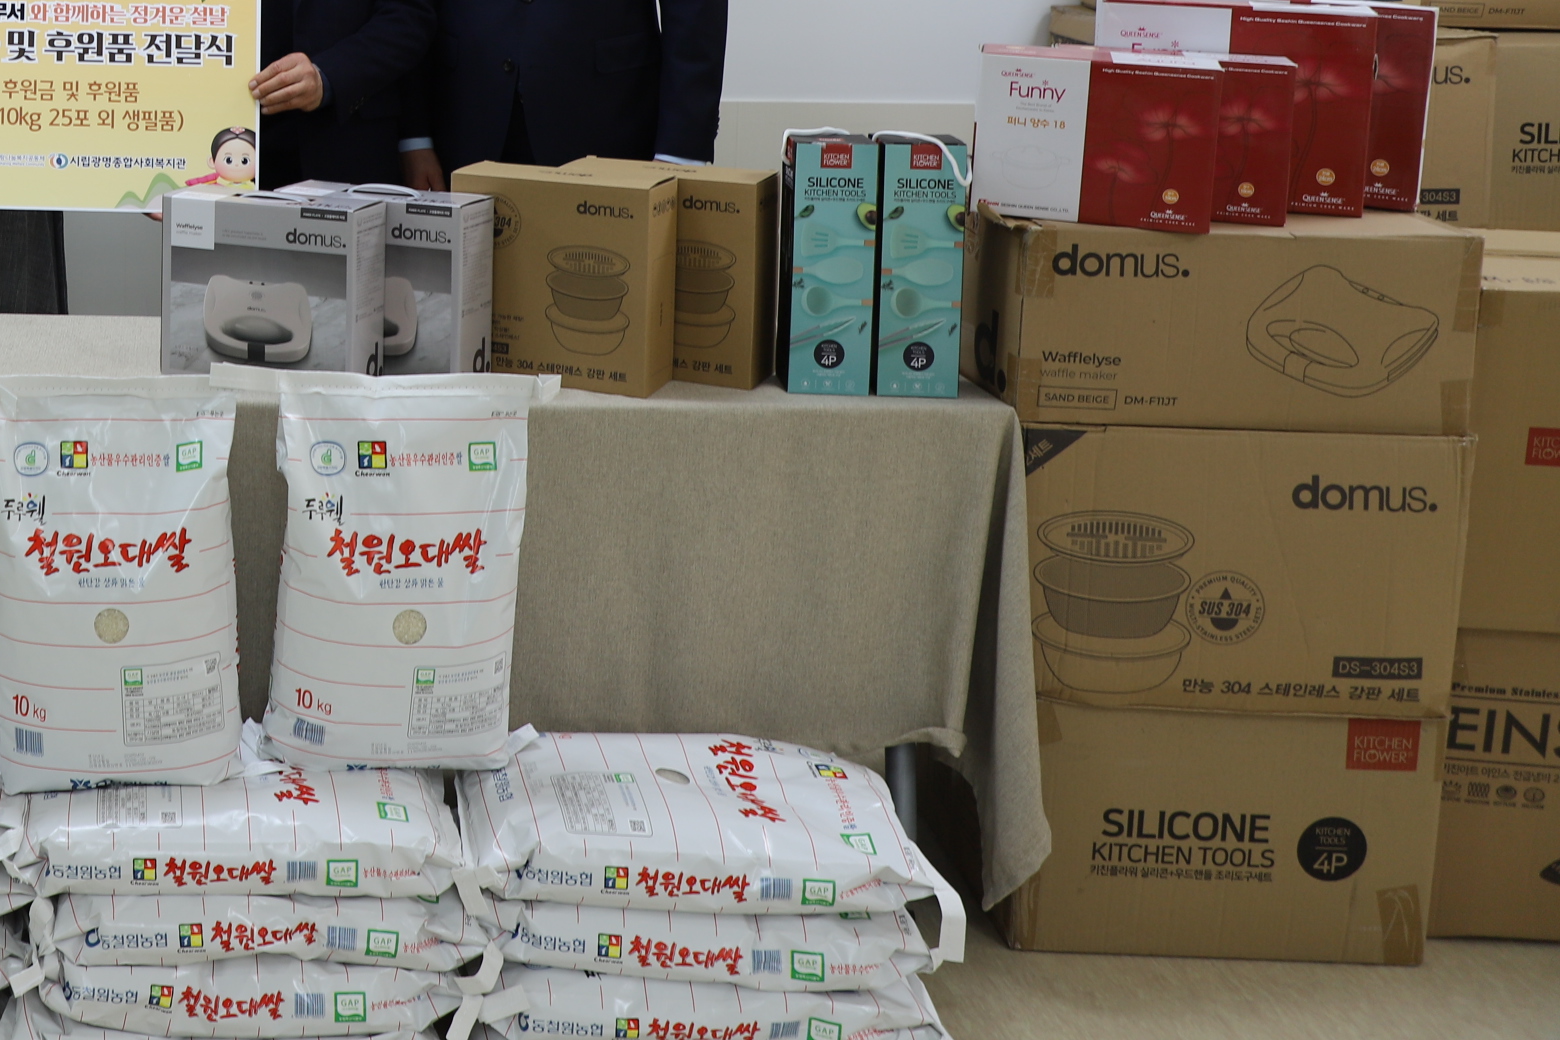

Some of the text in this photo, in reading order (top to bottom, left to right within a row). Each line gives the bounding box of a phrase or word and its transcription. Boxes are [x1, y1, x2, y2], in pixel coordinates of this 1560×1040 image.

[29, 3, 49, 21] 와
[53, 2, 126, 24] 함께하는
[130, 4, 186, 26] 정겨운
[190, 6, 228, 27] 설날
[7, 29, 37, 62] 및
[45, 31, 137, 65] 후원품
[143, 32, 234, 67] 전달식
[2, 79, 140, 103] 후원금 및 후원품
[1009, 80, 1066, 103] Funny
[49, 109, 90, 129] 25포
[97, 109, 115, 130] 외
[122, 109, 185, 133] 생필품)
[1007, 116, 1066, 129] 퍼니 양수 18
[70, 156, 187, 170] 시립광명종합사회복지관
[807, 177, 864, 189] SILICONE
[897, 178, 954, 190] SILICONE
[804, 188, 839, 198] KITCHEN
[894, 189, 956, 199] KITCHEN TOOLS
[286, 228, 346, 249] domus.
[821, 355, 837, 366] 4P
[910, 357, 926, 368] 4P
[1042, 351, 1122, 367] Wafflelyse
[1040, 368, 1117, 380] waffle maker
[1044, 392, 1075, 403] SAND
[1078, 394, 1109, 404] BEIGE
[25, 527, 192, 576] 철원오대쌀
[327, 528, 487, 576] 철원오대쌀
[1195, 575, 1257, 597] PREMIUM QUALITY
[1199, 601, 1251, 617] SUS 304
[1339, 661, 1418, 676] DS-304S3
[1182, 678, 1420, 702] 만능 304 스테인레스 강판 세트
[1451, 681, 1506, 695] Premium
[1354, 749, 1407, 763] FLOWER
[1481, 766, 1510, 778] 아인스
[1102, 808, 1271, 843] SILICONE
[1092, 842, 1275, 868] KITCHEN TOOLS
[1313, 852, 1347, 874] 4P
[1091, 865, 1272, 882] 키친플라워 실리콘+우드핸들 조리도구세트
